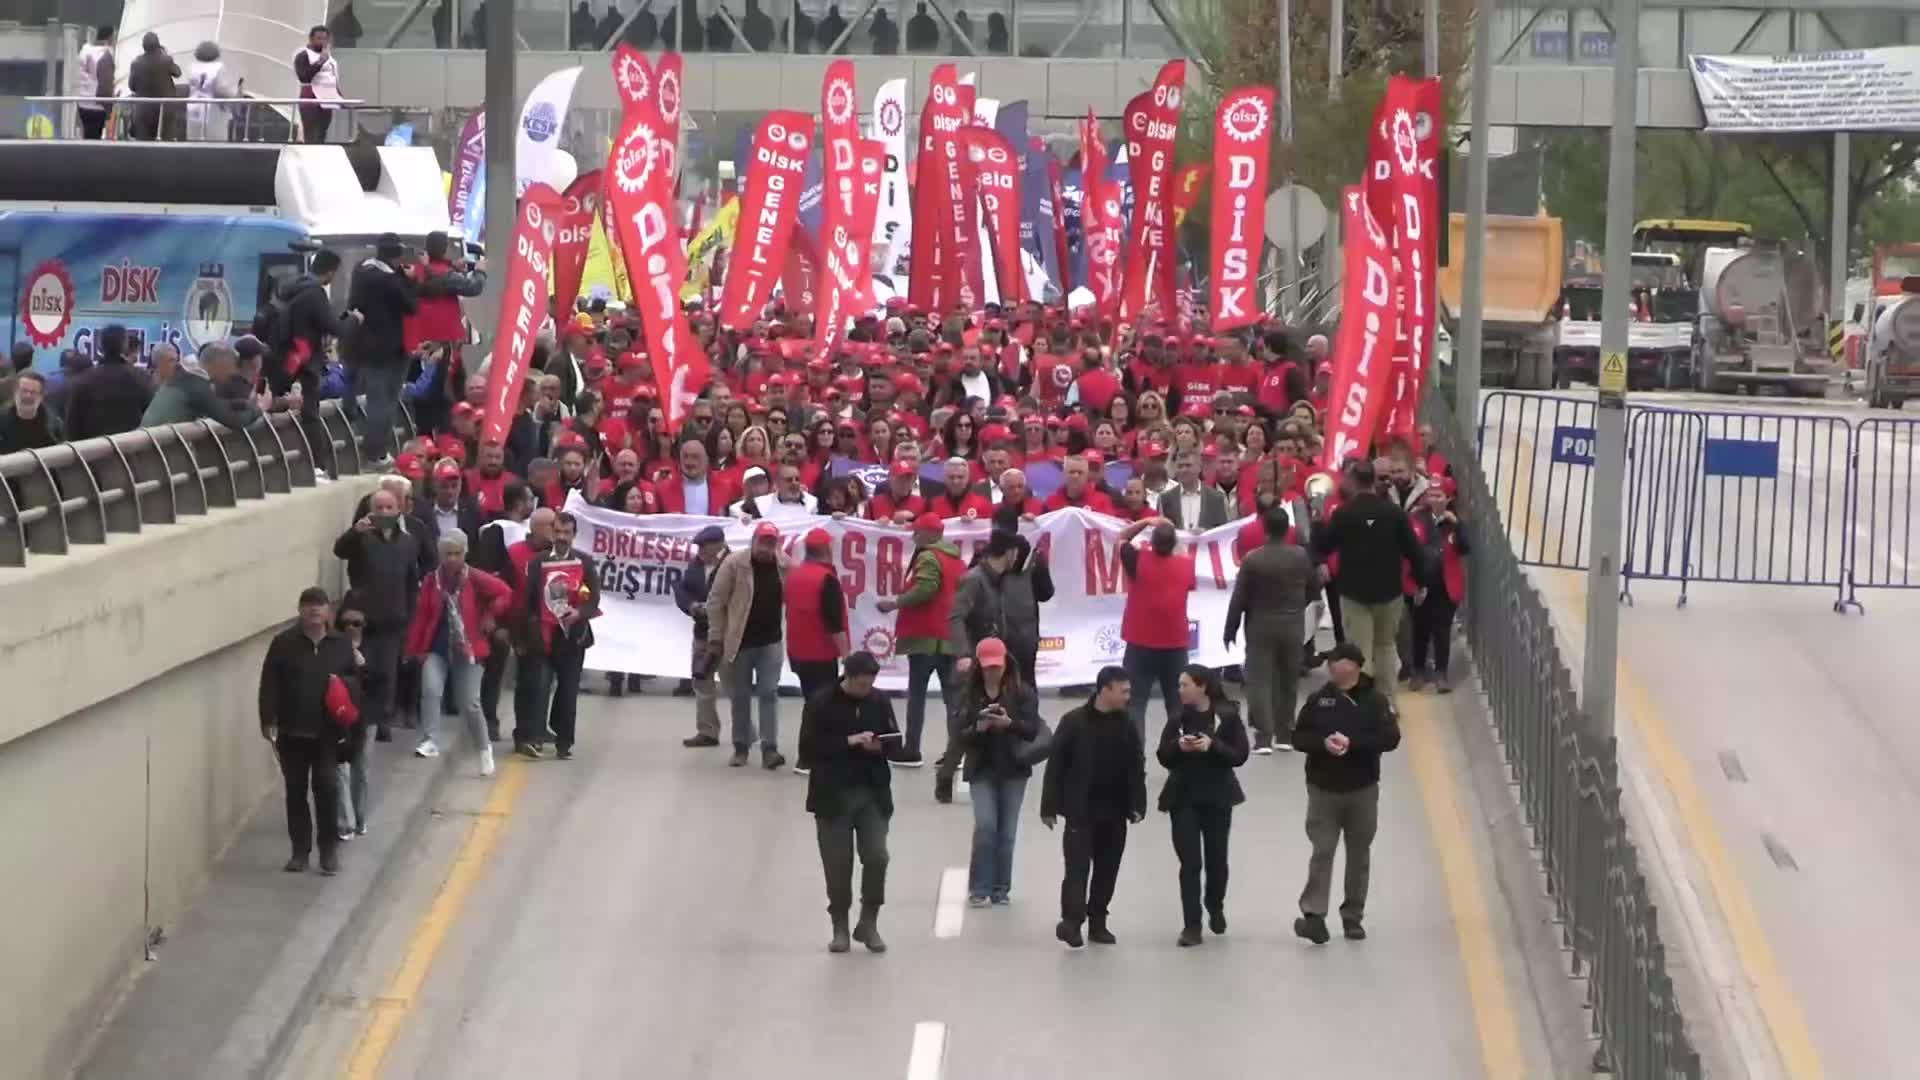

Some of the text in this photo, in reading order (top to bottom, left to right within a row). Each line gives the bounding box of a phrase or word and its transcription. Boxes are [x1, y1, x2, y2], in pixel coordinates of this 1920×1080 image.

[758, 147, 805, 173] DİSK
[101, 257, 161, 304] DİSK
[1218, 155, 1256, 319] DİSK
[1330, 256, 1390, 472] DİSK
